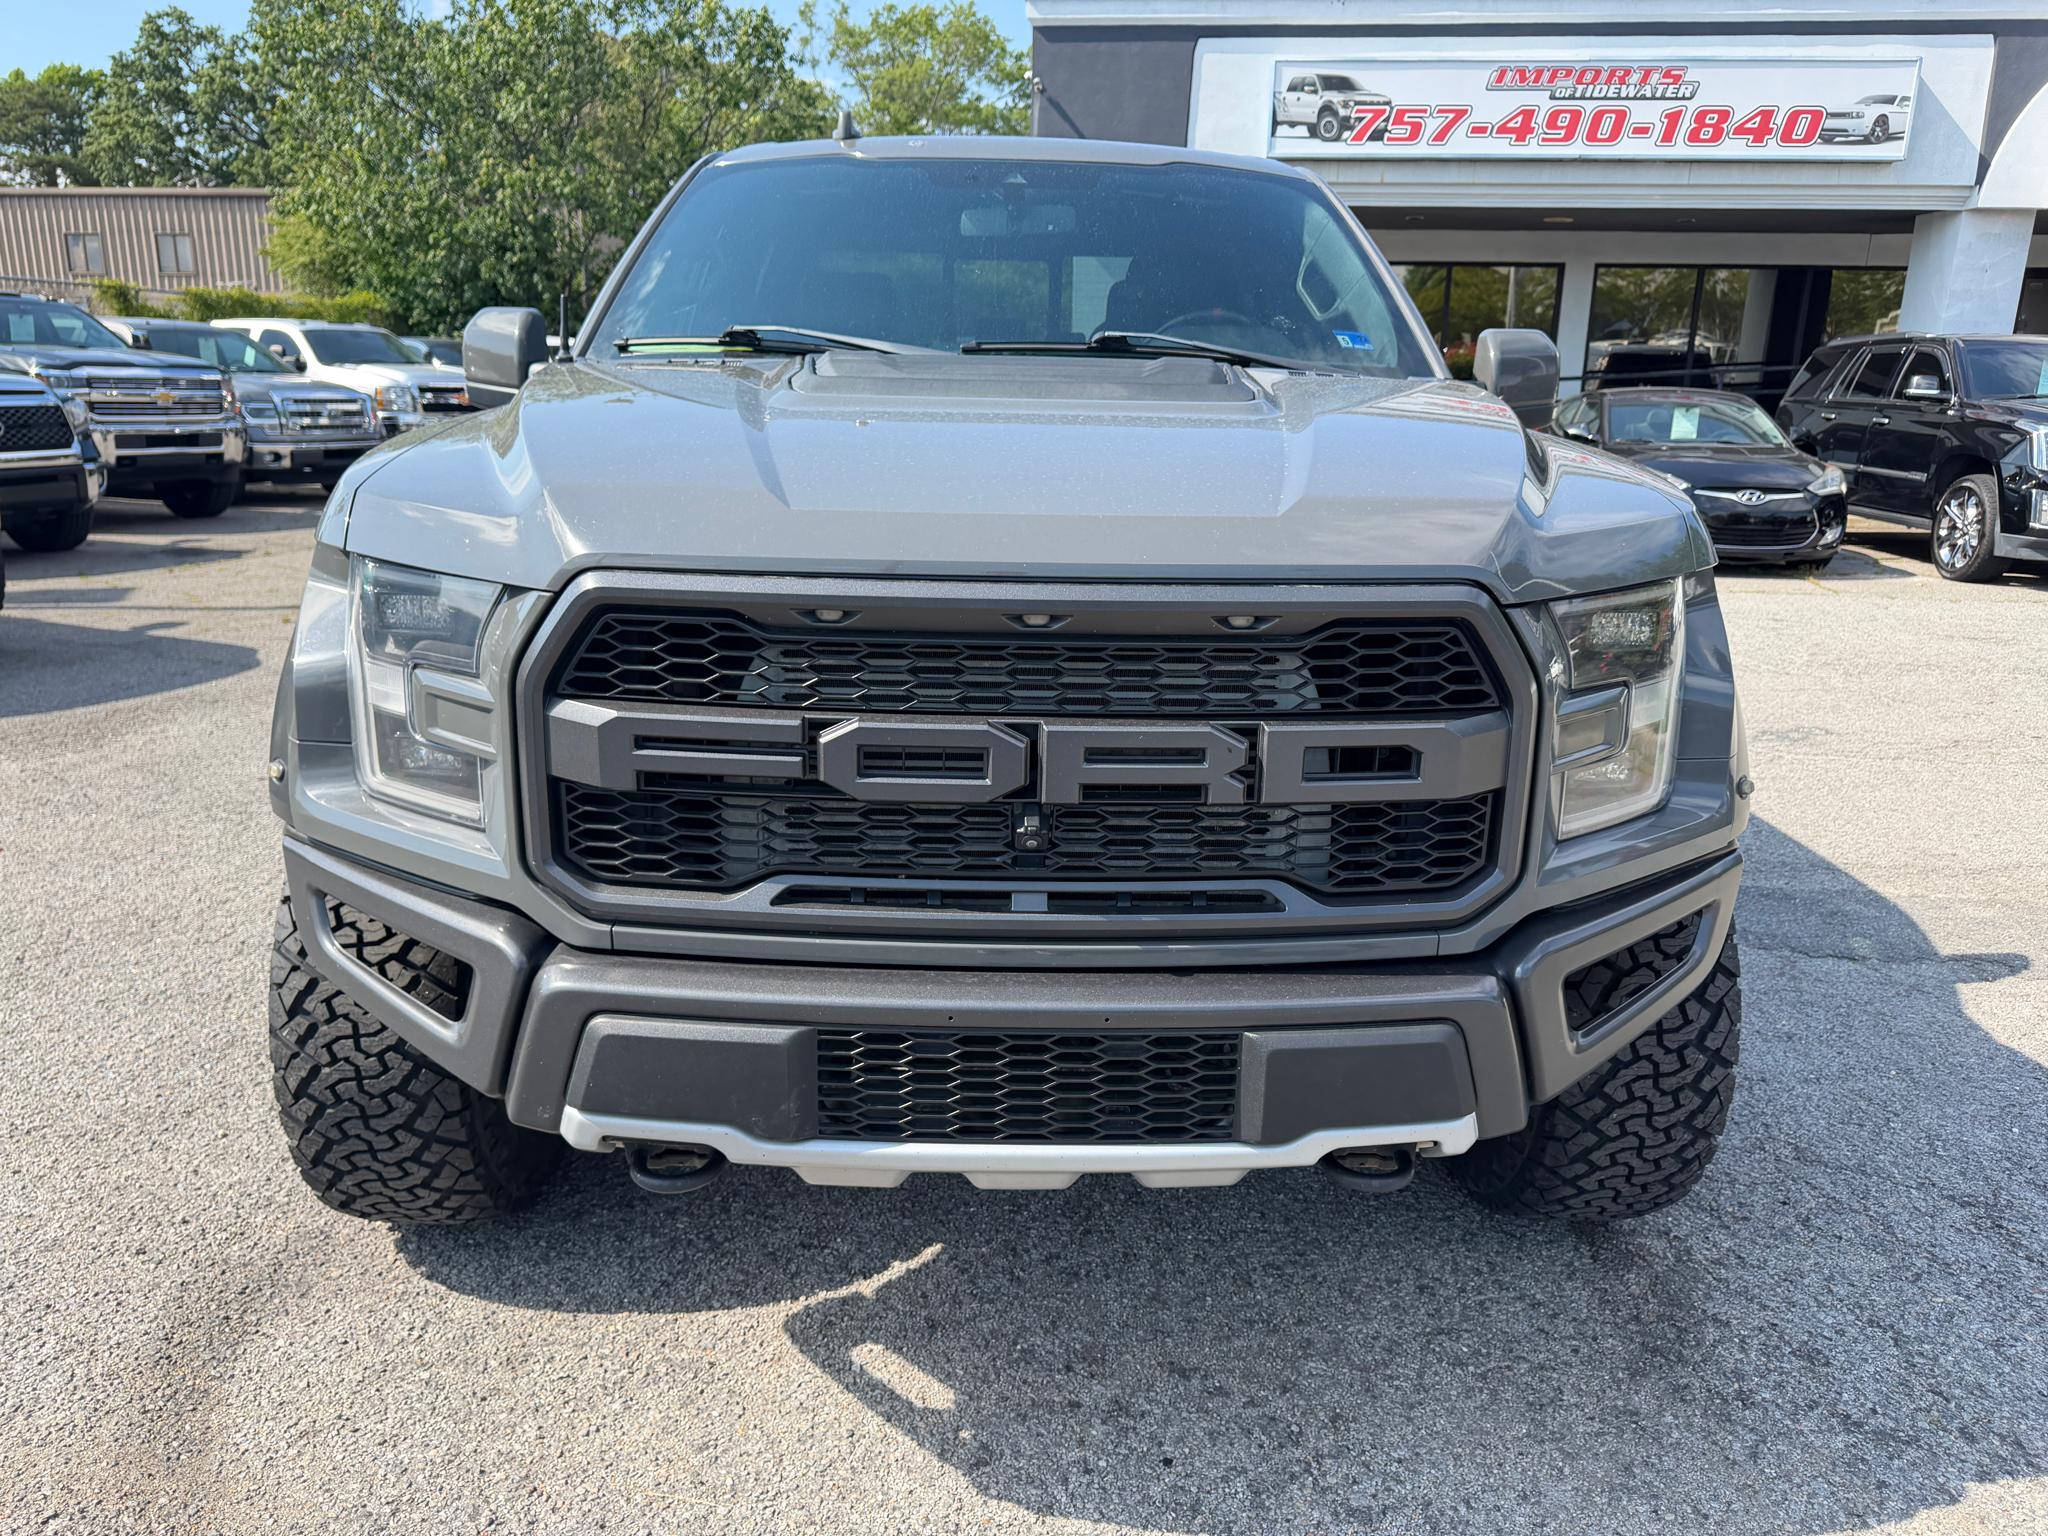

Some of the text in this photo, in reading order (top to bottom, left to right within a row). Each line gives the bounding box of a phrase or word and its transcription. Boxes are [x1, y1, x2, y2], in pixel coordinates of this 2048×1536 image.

[1491, 65, 1689, 86] IMPORTS
[1573, 84, 1695, 98] TIDEWATER
[1346, 105, 1827, 147] 757-490-1840
[547, 698, 1510, 804] FORD
